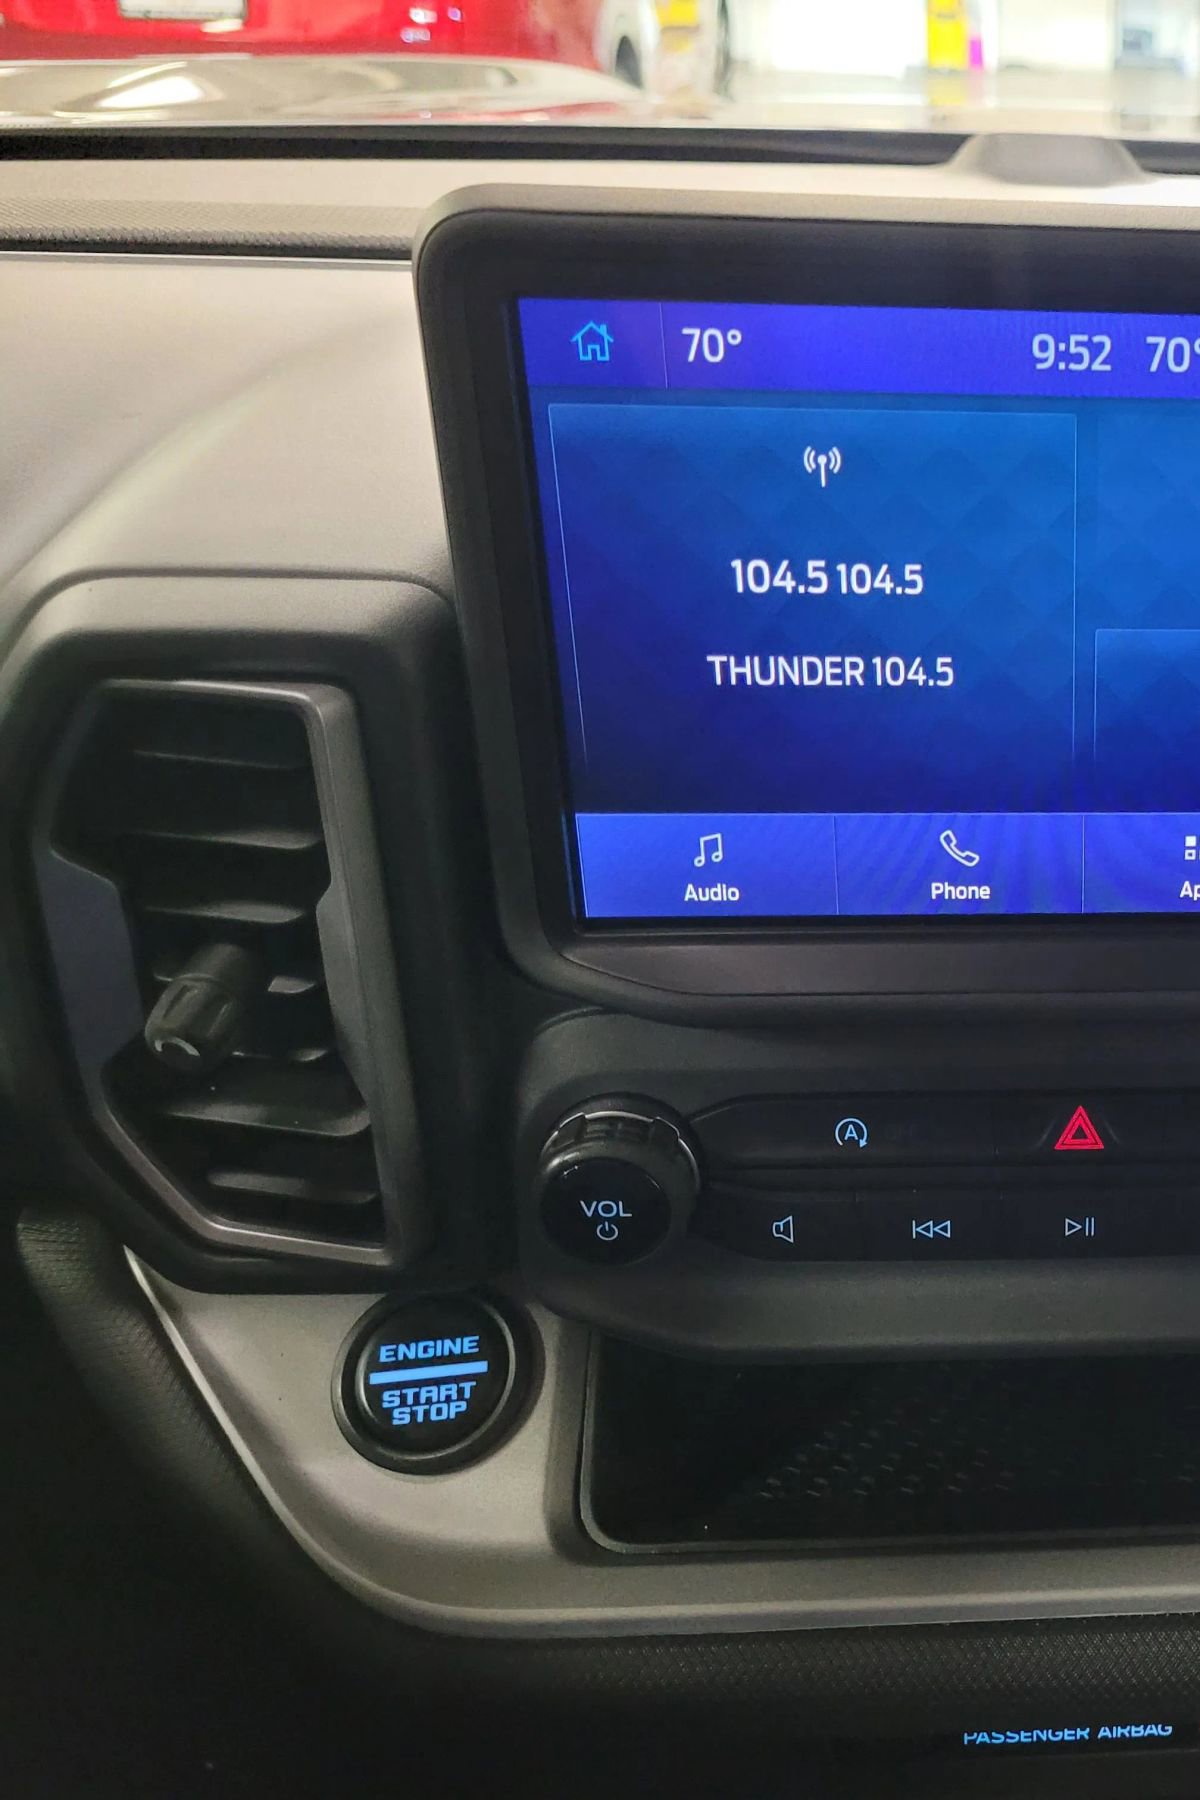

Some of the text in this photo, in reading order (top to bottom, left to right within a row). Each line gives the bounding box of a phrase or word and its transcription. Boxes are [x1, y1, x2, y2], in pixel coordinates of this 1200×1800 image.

[681, 327, 743, 363] 70°
[1031, 333, 1112, 372] 9:52
[731, 558, 924, 595] 104.5 104.5
[706, 655, 955, 687] THUNDER 104.5
[684, 883, 740, 902] Audio
[930, 882, 991, 900] Phone
[580, 1199, 633, 1218] VOL
[379, 1335, 480, 1363] ENGINE
[382, 1381, 477, 1408] START
[392, 1401, 468, 1425] STOP
[963, 1727, 1090, 1745] PASSENGER
[1097, 1723, 1173, 1739] AIRBAG
